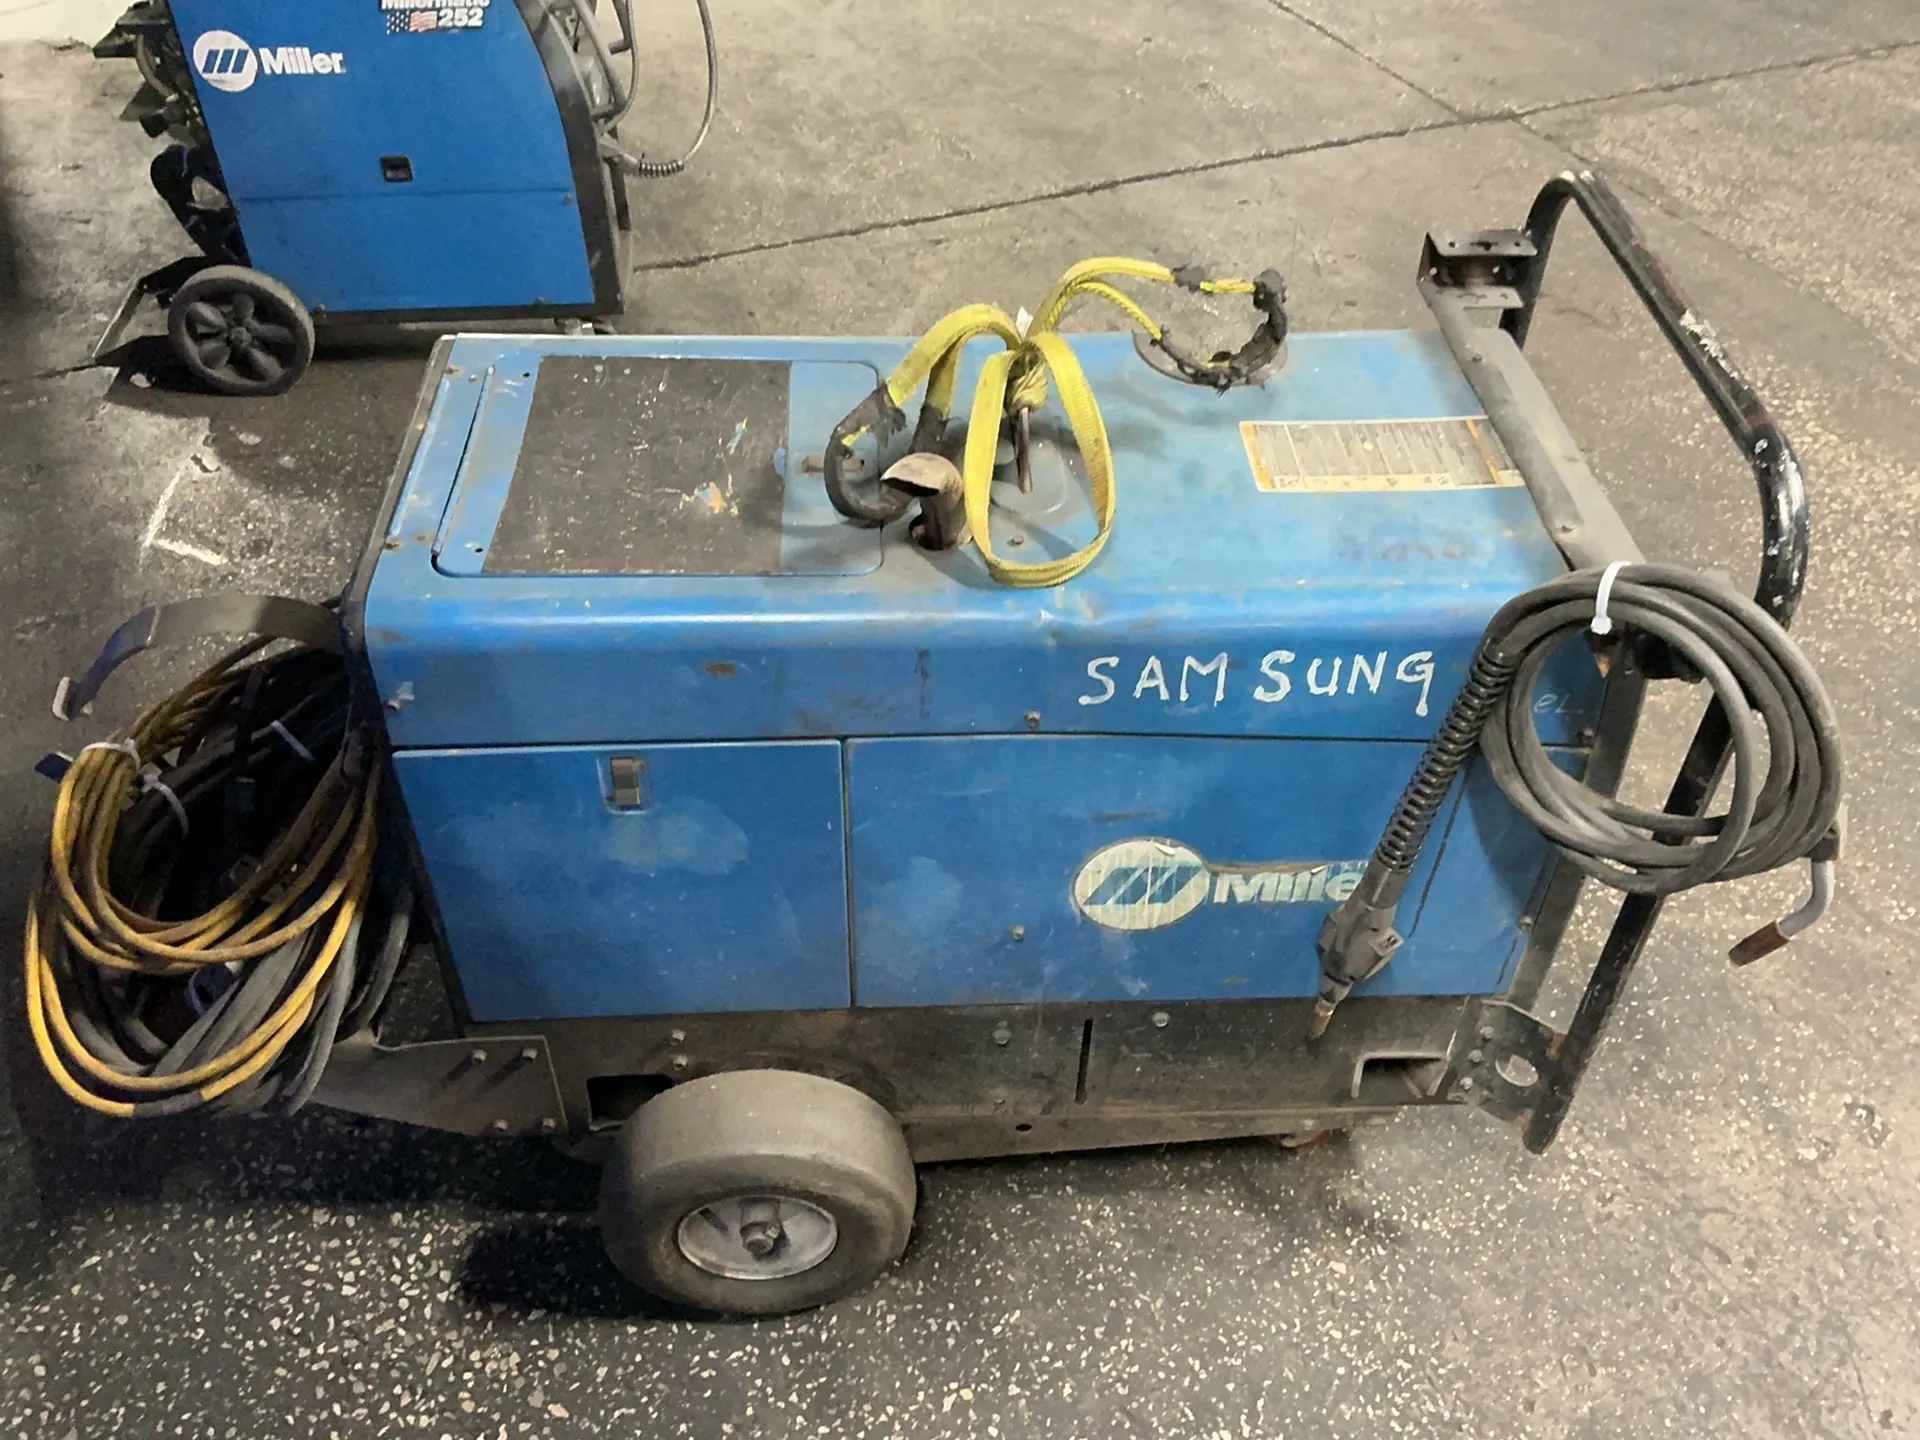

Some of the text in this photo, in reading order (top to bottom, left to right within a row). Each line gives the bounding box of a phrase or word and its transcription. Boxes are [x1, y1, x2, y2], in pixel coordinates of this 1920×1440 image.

[438, 8, 484, 27] 252
[259, 46, 344, 75] Miller
[1213, 867, 1366, 904] Mille
